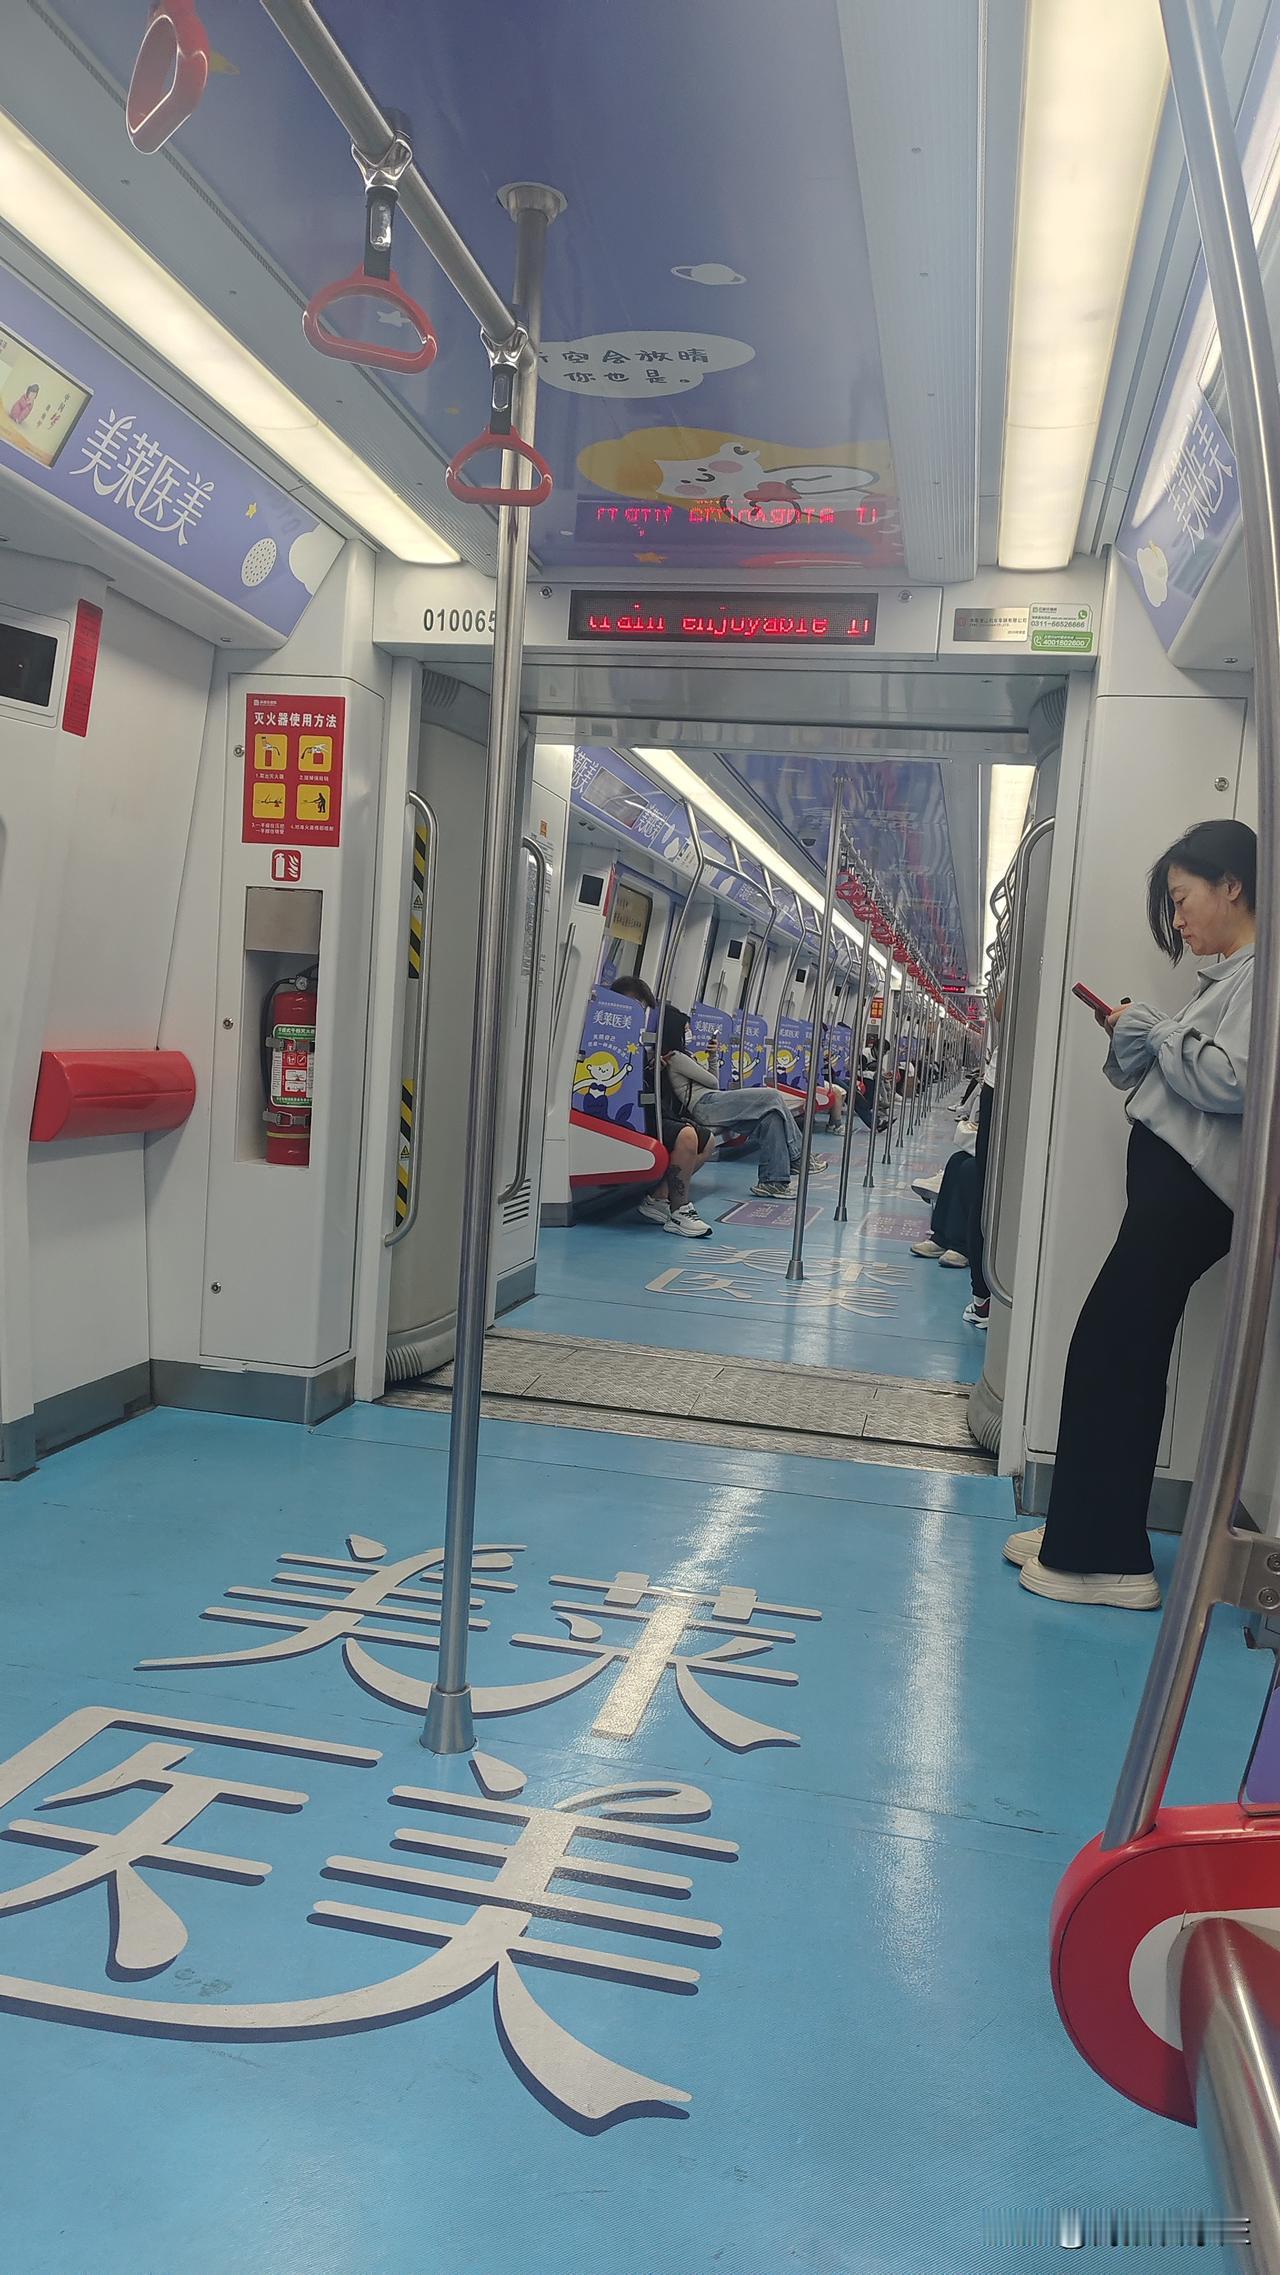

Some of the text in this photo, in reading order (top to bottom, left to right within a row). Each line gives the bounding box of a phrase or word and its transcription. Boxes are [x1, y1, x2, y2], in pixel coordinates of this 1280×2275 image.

[69, 408, 215, 546] 美莱医美
[254, 712, 337, 728] 灭火器使用方法
[592, 1009, 632, 1030] 美莱医美
[134, 1534, 822, 1752] 美莱
[0, 1706, 740, 2135] 医美
